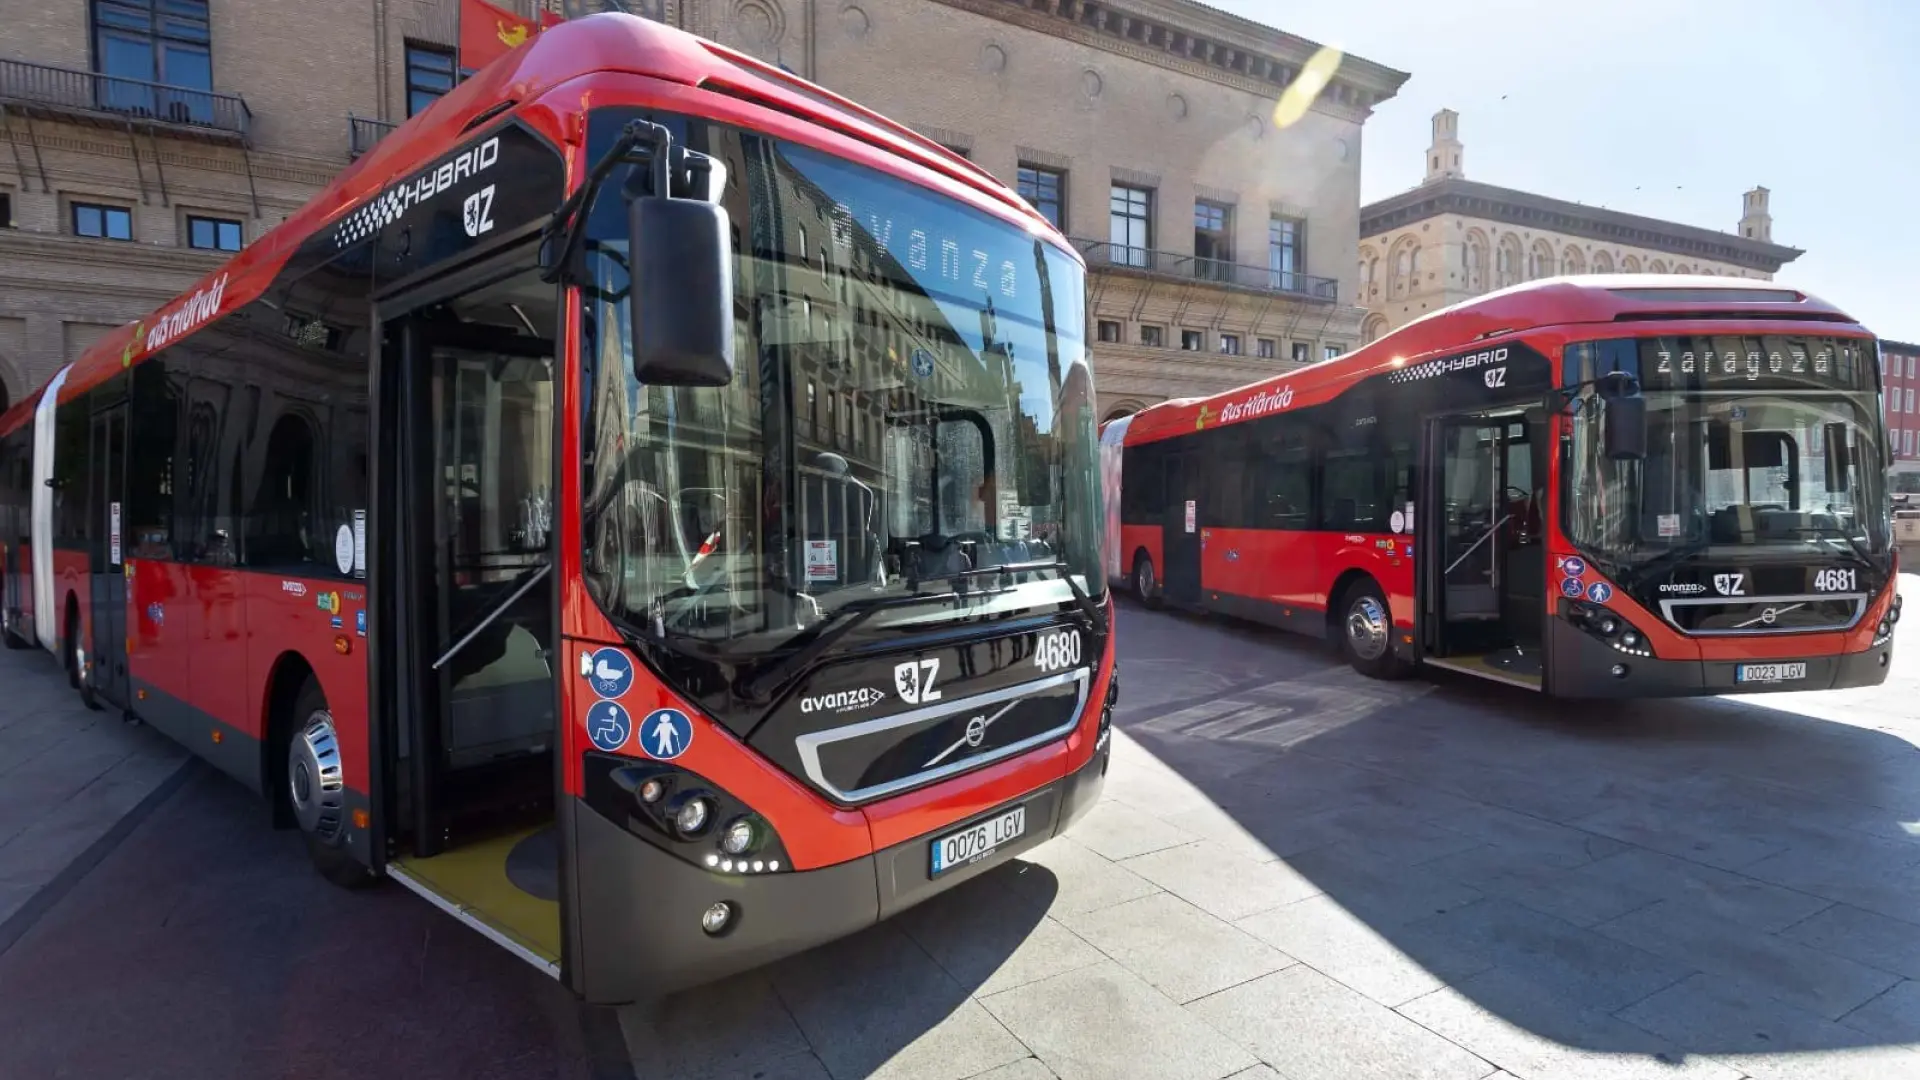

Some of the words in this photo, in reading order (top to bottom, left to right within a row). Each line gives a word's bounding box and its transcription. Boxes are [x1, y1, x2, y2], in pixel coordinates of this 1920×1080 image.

[404, 136, 499, 209] HYBRID
[832, 201, 1017, 298] avanza
[1442, 348, 1508, 373] HYBRID
[1657, 351, 1829, 381] zaragoza
[1659, 584, 1697, 593] avanza
[1813, 569, 1857, 592] 4681
[1033, 629, 1081, 672] 4680
[1746, 665, 1776, 680] 0023
[1781, 663, 1803, 679] LGV
[800, 687, 869, 714] avanza
[946, 826, 987, 864] 0076
[995, 811, 1021, 842] LGV
